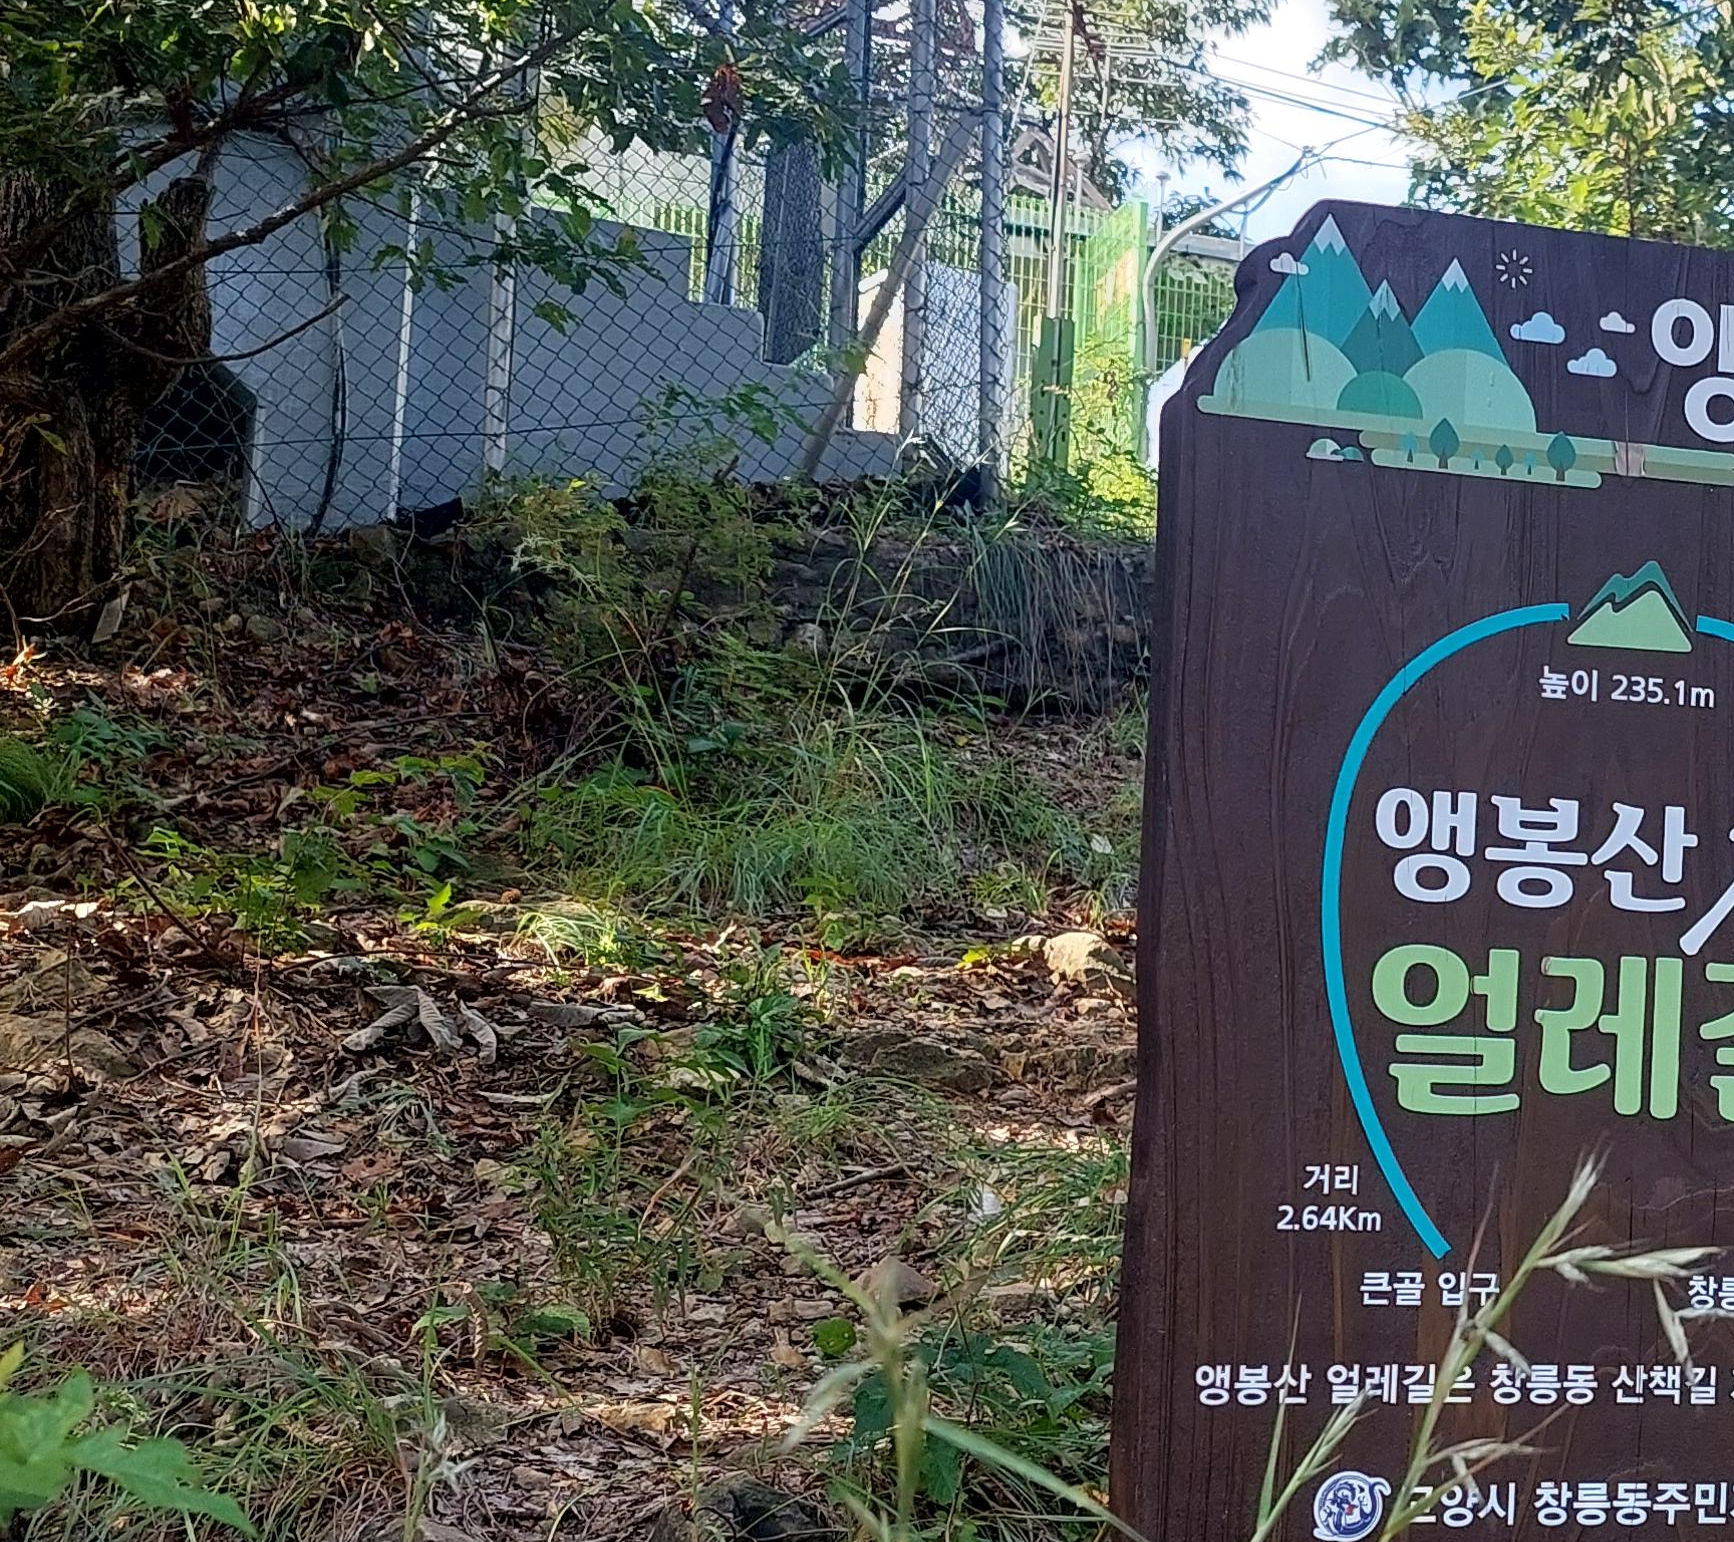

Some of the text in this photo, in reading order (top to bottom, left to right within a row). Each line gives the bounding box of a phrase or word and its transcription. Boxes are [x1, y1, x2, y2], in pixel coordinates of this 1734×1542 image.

[1538, 665, 1716, 708] 높이 235.1m
[1375, 787, 1699, 912] 앵봉산
[1303, 1163, 1360, 1196] 거리
[1276, 1204, 1382, 1232] 2.64Km
[1359, 1271, 1500, 1307] 큰골 입구
[1195, 1363, 1313, 1407] 앵봉산
[1326, 1363, 1476, 1405] 얼레길은
[1489, 1363, 1599, 1405] 창릉동
[1611, 1364, 1718, 1406] 산책길
